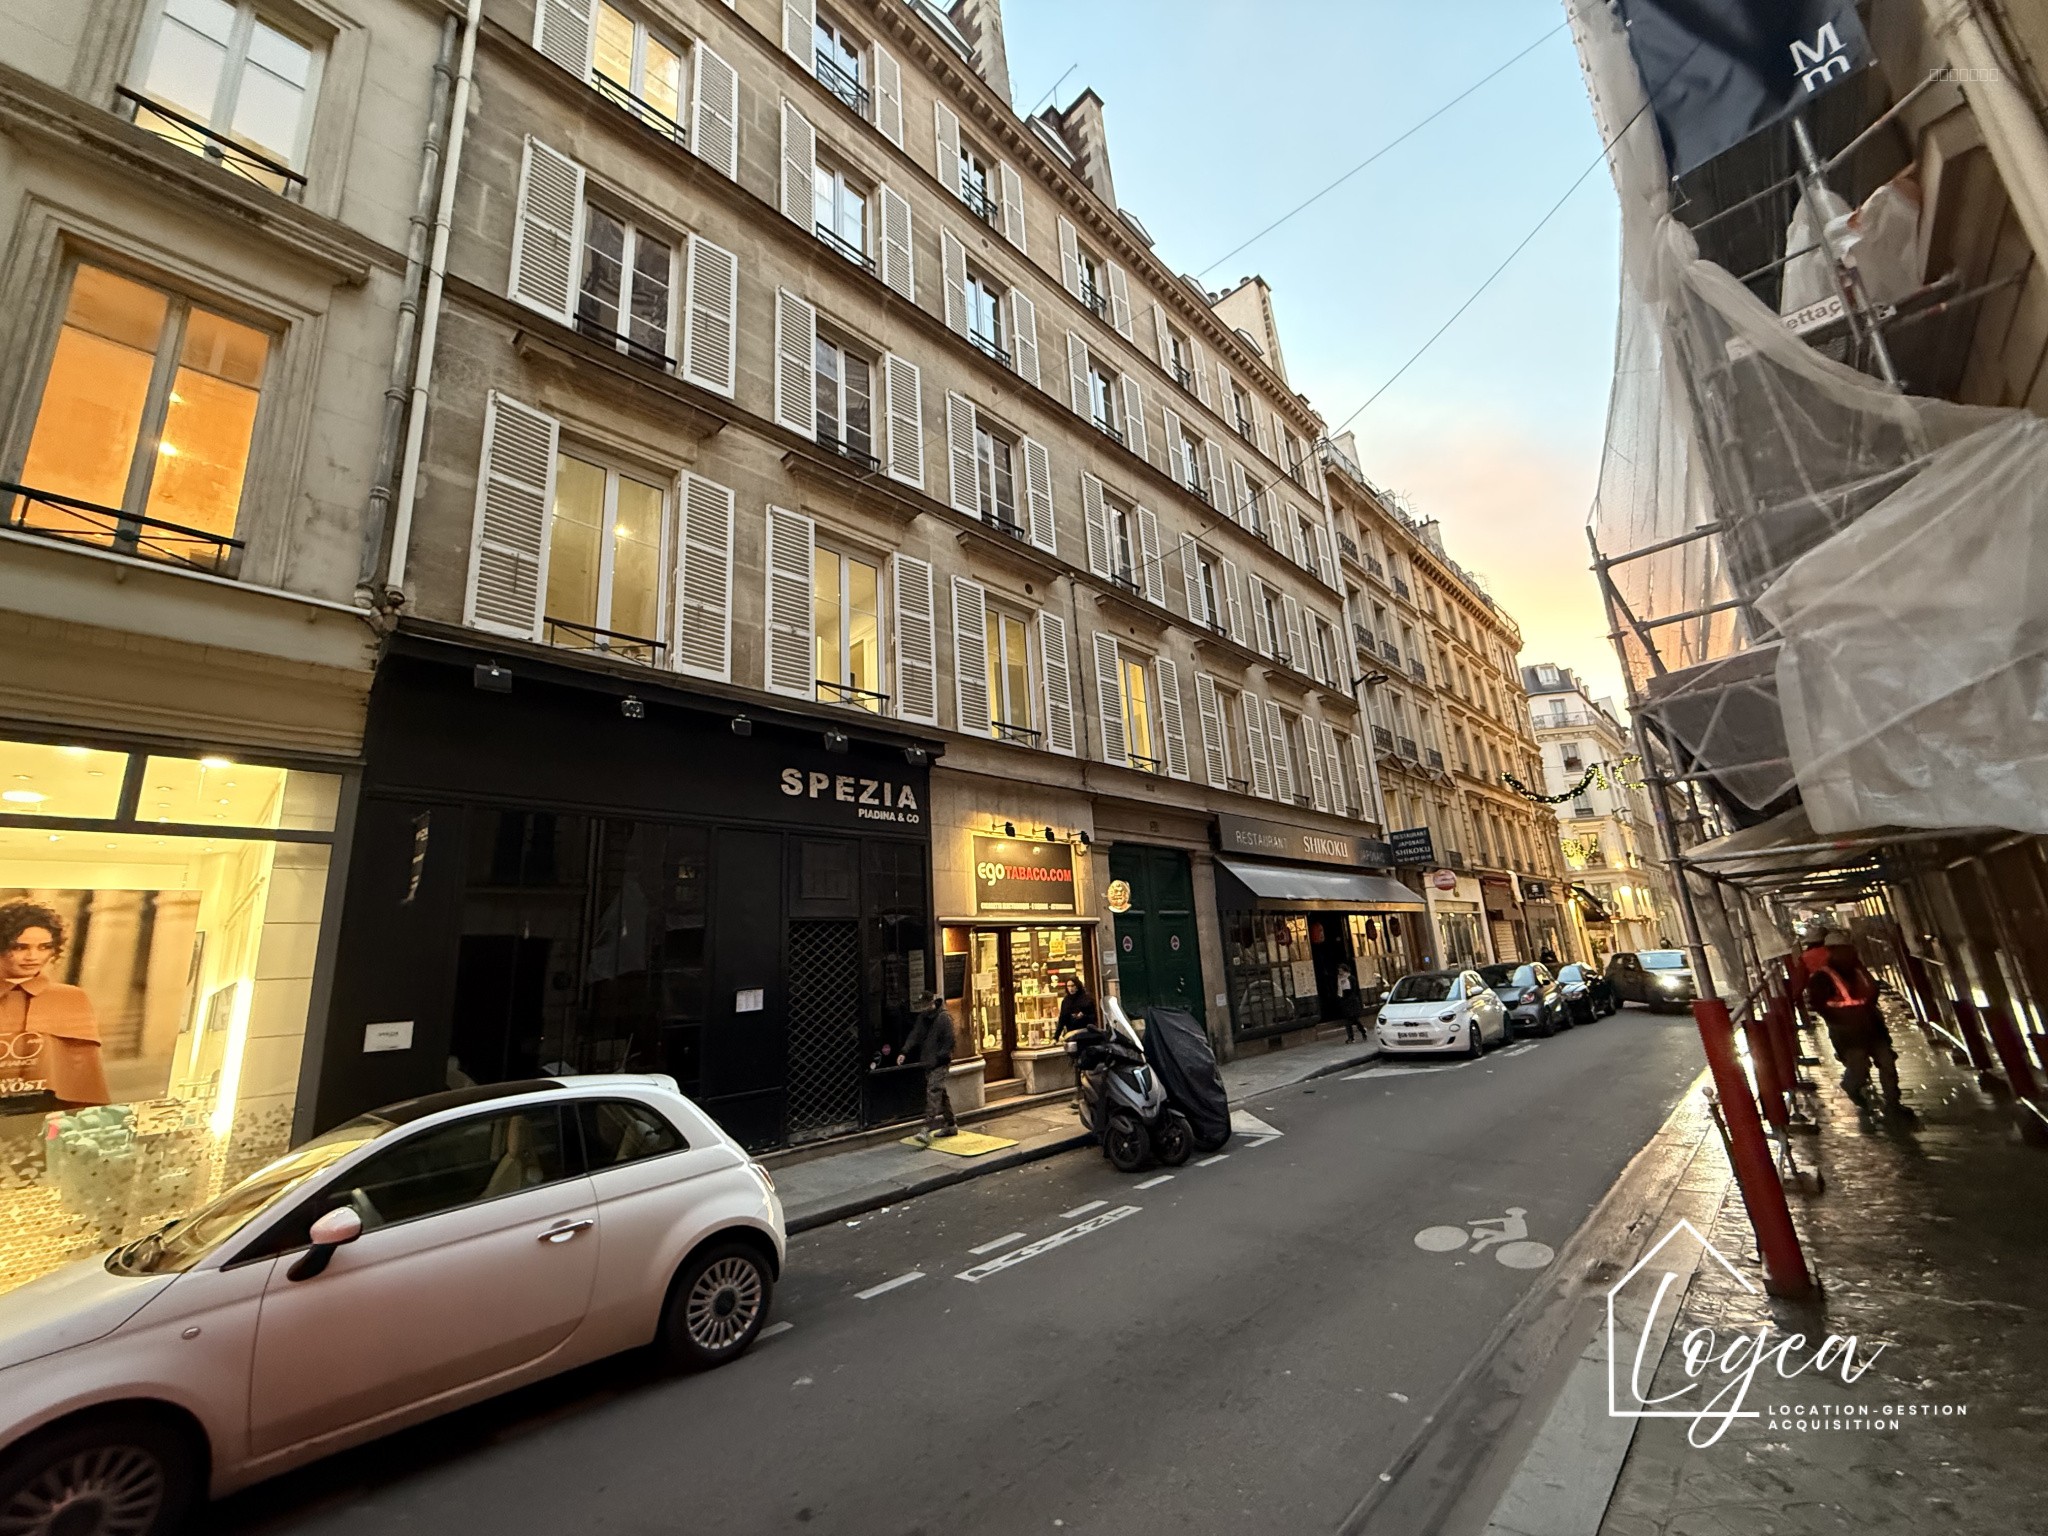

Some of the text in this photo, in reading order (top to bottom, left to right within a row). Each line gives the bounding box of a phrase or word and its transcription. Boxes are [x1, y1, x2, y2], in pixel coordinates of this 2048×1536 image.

[780, 767, 918, 810] SPEZIA
[858, 808, 920, 824] PIADINA & CO
[1303, 835, 1349, 858] SHIKOKU
[1395, 846, 1431, 857] SHIKOKU
